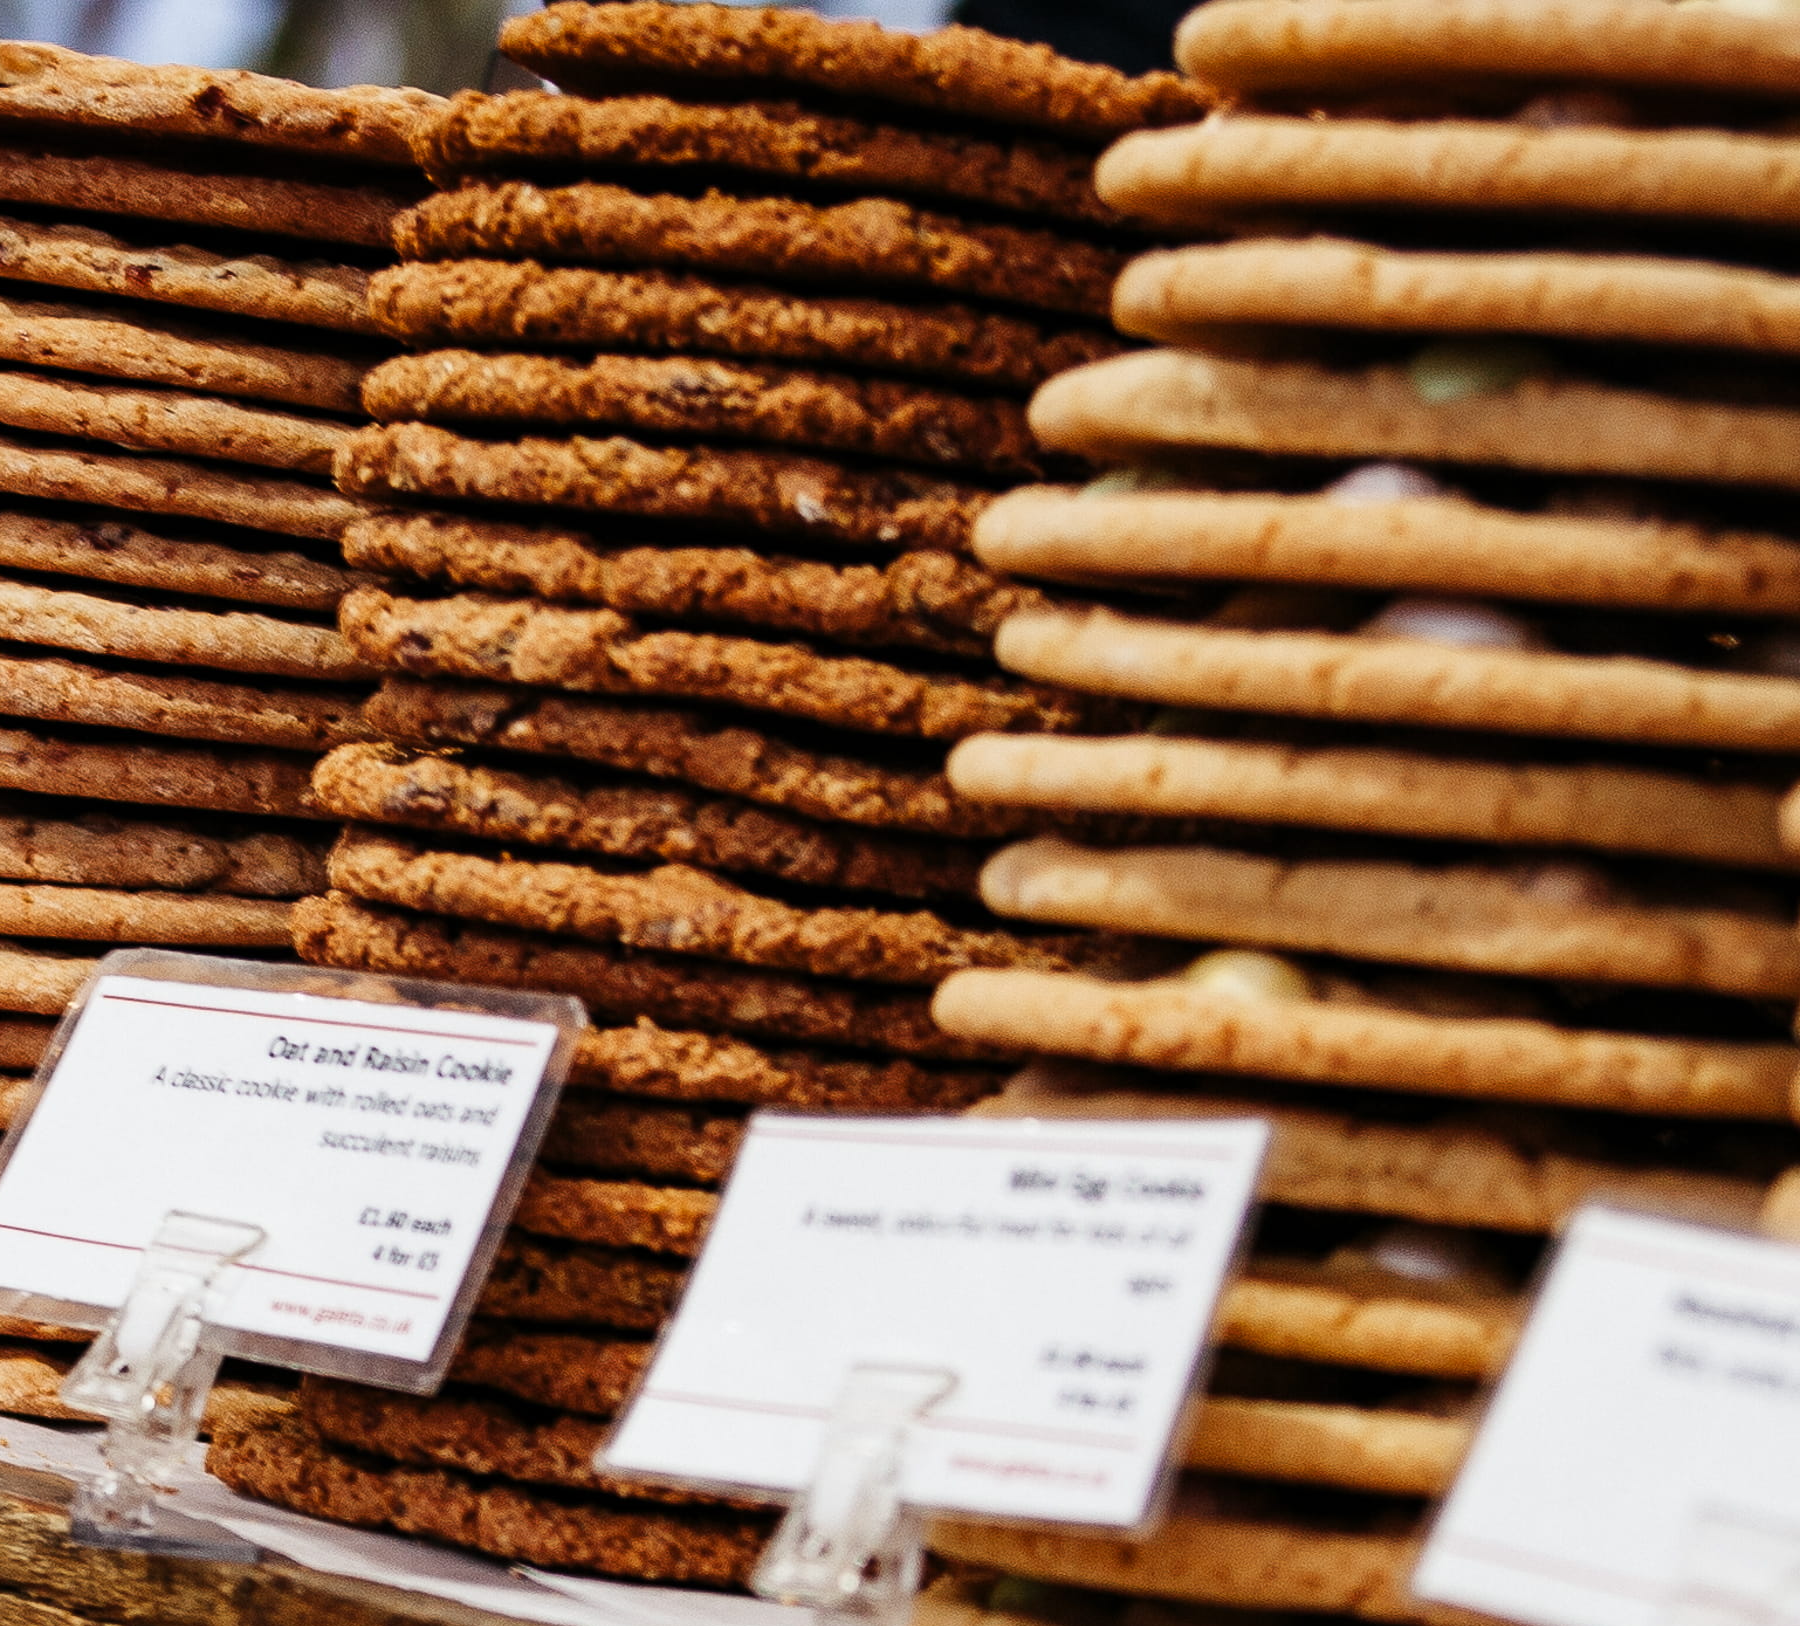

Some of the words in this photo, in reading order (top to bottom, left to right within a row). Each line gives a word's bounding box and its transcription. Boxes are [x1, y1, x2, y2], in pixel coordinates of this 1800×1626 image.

[269, 1036, 309, 1061] Oat
[313, 1042, 359, 1067] and
[365, 1047, 430, 1074] Raisin
[437, 1054, 514, 1085] Cookie
[152, 1064, 166, 1085] A
[170, 1068, 232, 1094] classic
[235, 1077, 299, 1104] cookie
[305, 1085, 347, 1108] with
[352, 1092, 410, 1117] rolled
[412, 1099, 454, 1122] oats
[459, 1104, 501, 1129] and
[318, 1128, 414, 1158] succulent
